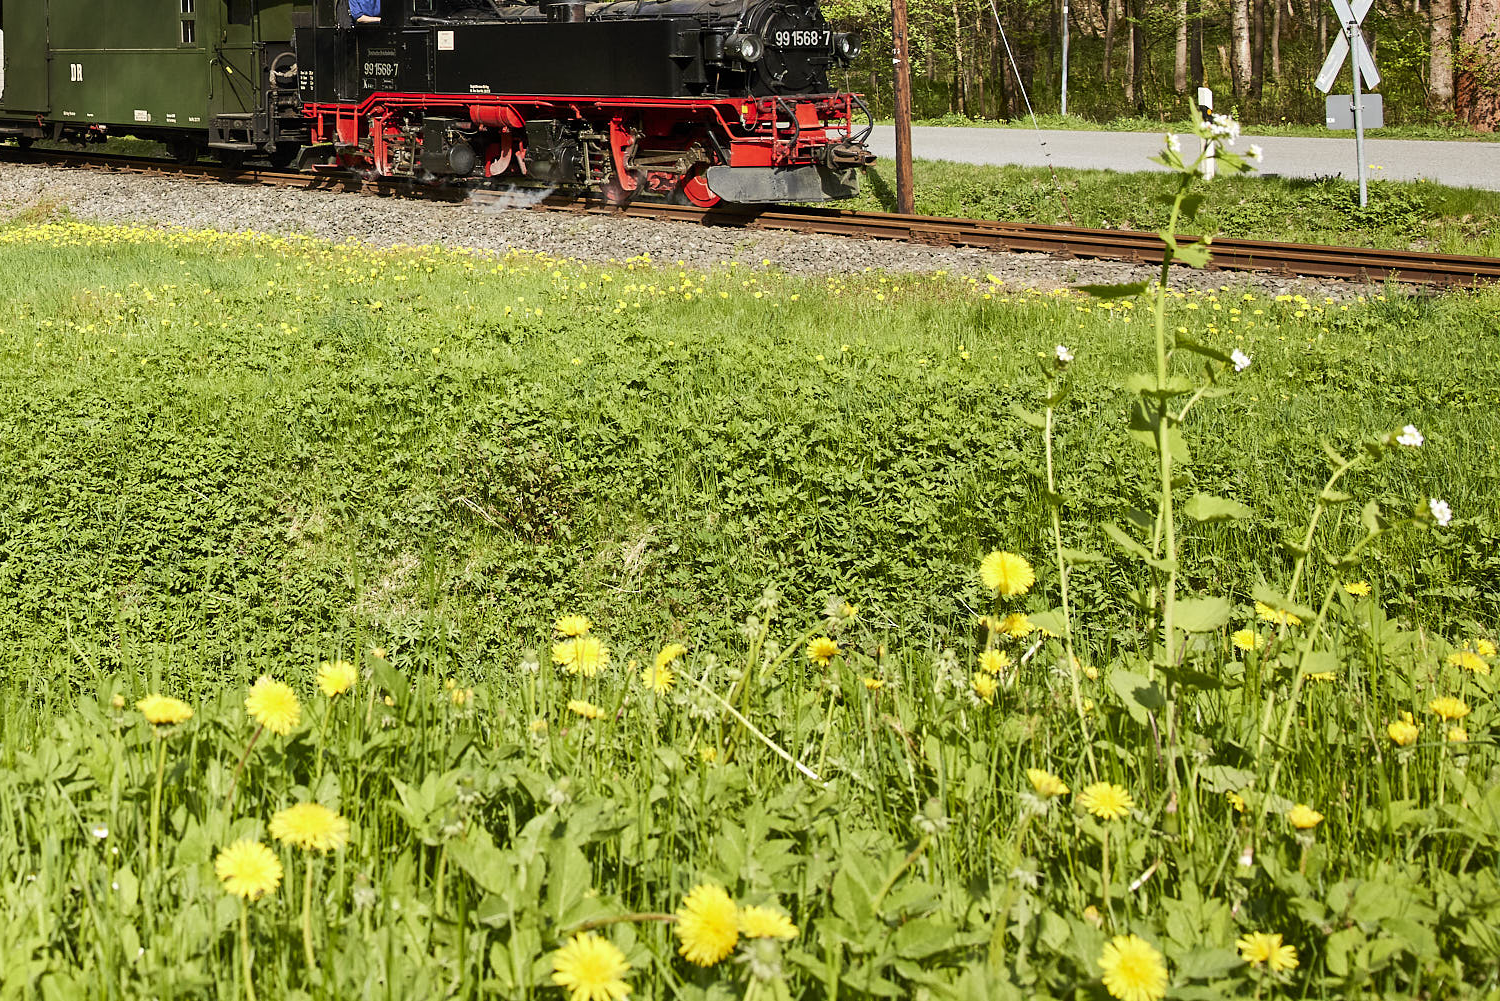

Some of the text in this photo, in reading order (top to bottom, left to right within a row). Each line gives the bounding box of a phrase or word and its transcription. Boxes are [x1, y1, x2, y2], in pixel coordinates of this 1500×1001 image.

[775, 30, 790, 46] 99
[70, 63, 83, 82] DR
[364, 62, 374, 75] 99
